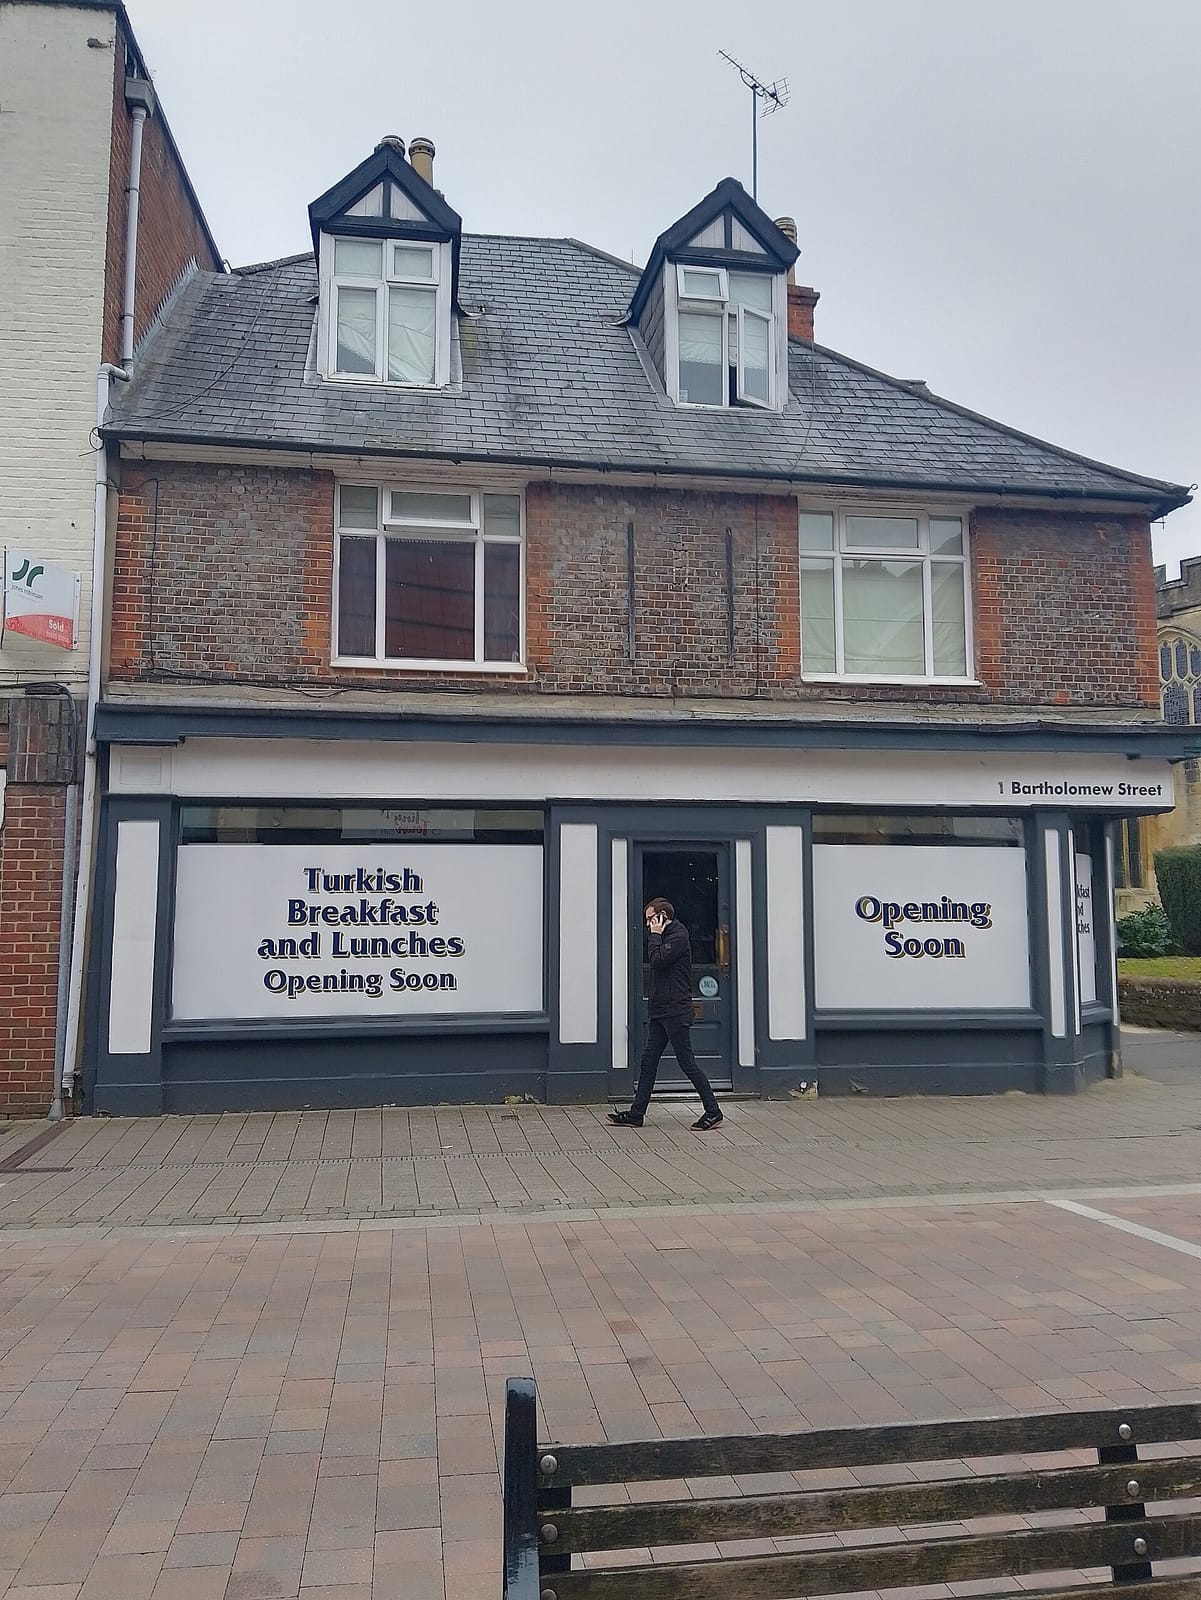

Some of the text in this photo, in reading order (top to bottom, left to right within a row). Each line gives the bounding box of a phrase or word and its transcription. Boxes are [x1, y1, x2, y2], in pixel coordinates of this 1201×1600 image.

[48, 619, 65, 633] Sold
[998, 781, 1162, 796] 1 Bartholomew Street
[304, 867, 423, 893] Turkish
[287, 898, 439, 926] Breakfast
[854, 895, 993, 930] Opening
[257, 930, 466, 959] and Lunches
[884, 931, 966, 959] Soon
[263, 967, 457, 999] Opening Soon
